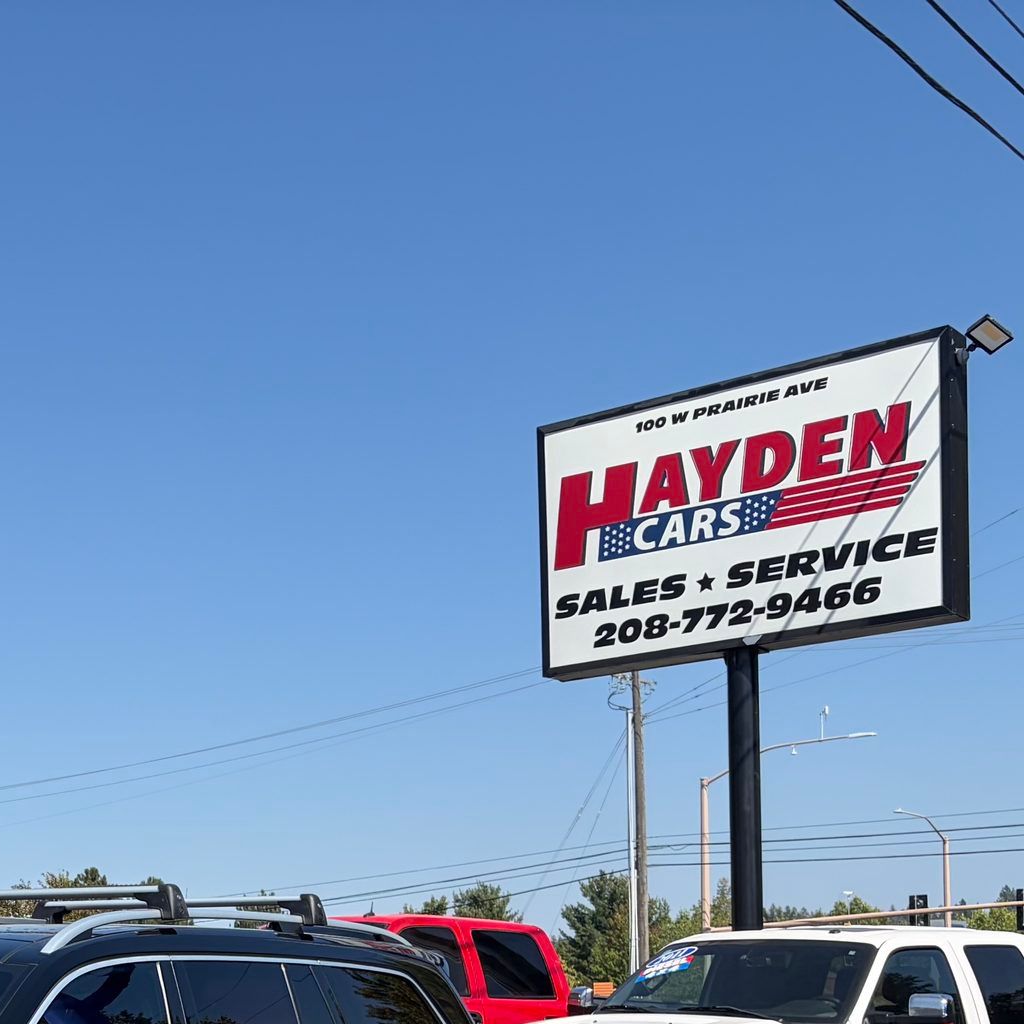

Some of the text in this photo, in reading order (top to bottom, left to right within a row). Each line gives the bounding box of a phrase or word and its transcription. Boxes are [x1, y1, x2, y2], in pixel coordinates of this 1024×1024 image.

[635, 377, 828, 433] 100 W PRAIRIE AVE
[554, 401, 912, 571] HAYDEN
[632, 501, 743, 551] CARS
[554, 527, 938, 619] SALES SERVICE
[593, 576, 883, 649] 208-772-9466
